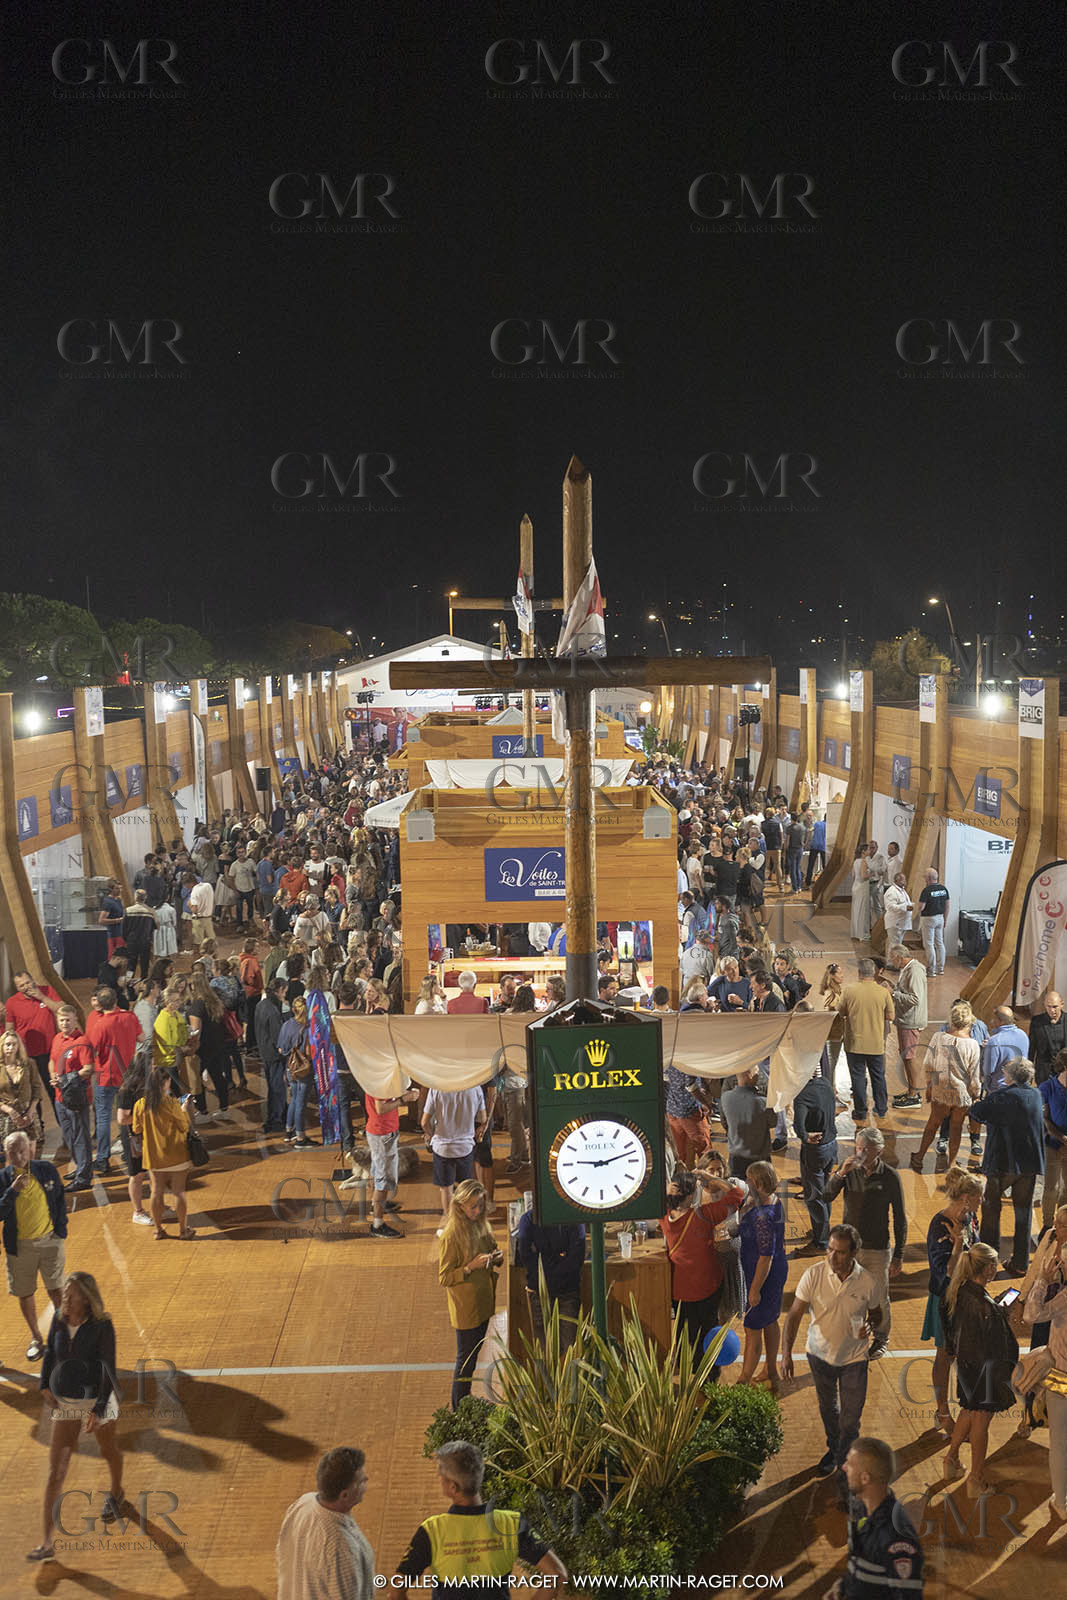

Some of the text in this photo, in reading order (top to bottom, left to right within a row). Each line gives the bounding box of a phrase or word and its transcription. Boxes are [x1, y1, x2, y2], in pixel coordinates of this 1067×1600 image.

[1020, 705, 1042, 719] BRIG
[977, 787, 998, 802] BRIG
[498, 851, 562, 888] Les Voiles
[553, 1069, 643, 1091] ROLEX
[585, 1142, 616, 1151] ROLEX
